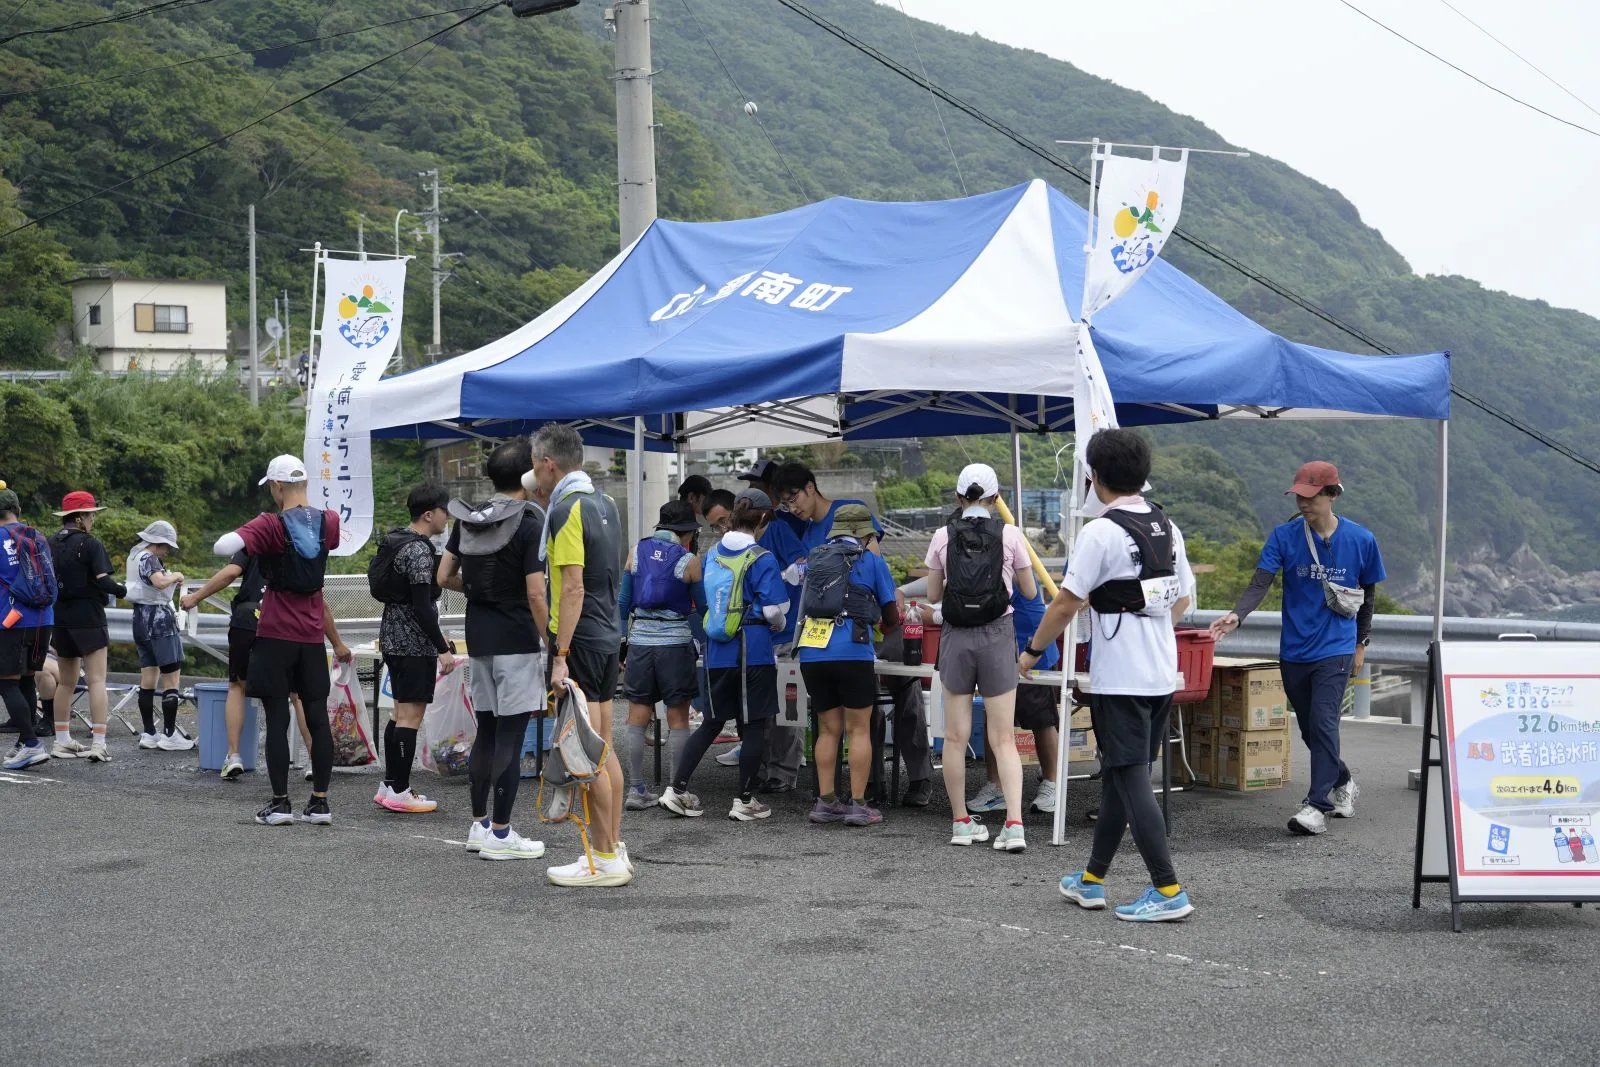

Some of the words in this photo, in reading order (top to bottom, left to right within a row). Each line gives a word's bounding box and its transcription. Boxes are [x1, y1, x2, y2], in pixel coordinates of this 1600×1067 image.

[337, 361, 367, 524] 愛南マラニック
[1505, 682, 1574, 696] 愛南マラニック
[1507, 696, 1549, 709] 2026
[1518, 714, 1600, 733] 32.6km地点
[1500, 740, 1597, 767] 武者泊給水所
[1496, 779, 1578, 795] 次のエイドまで4.6km
